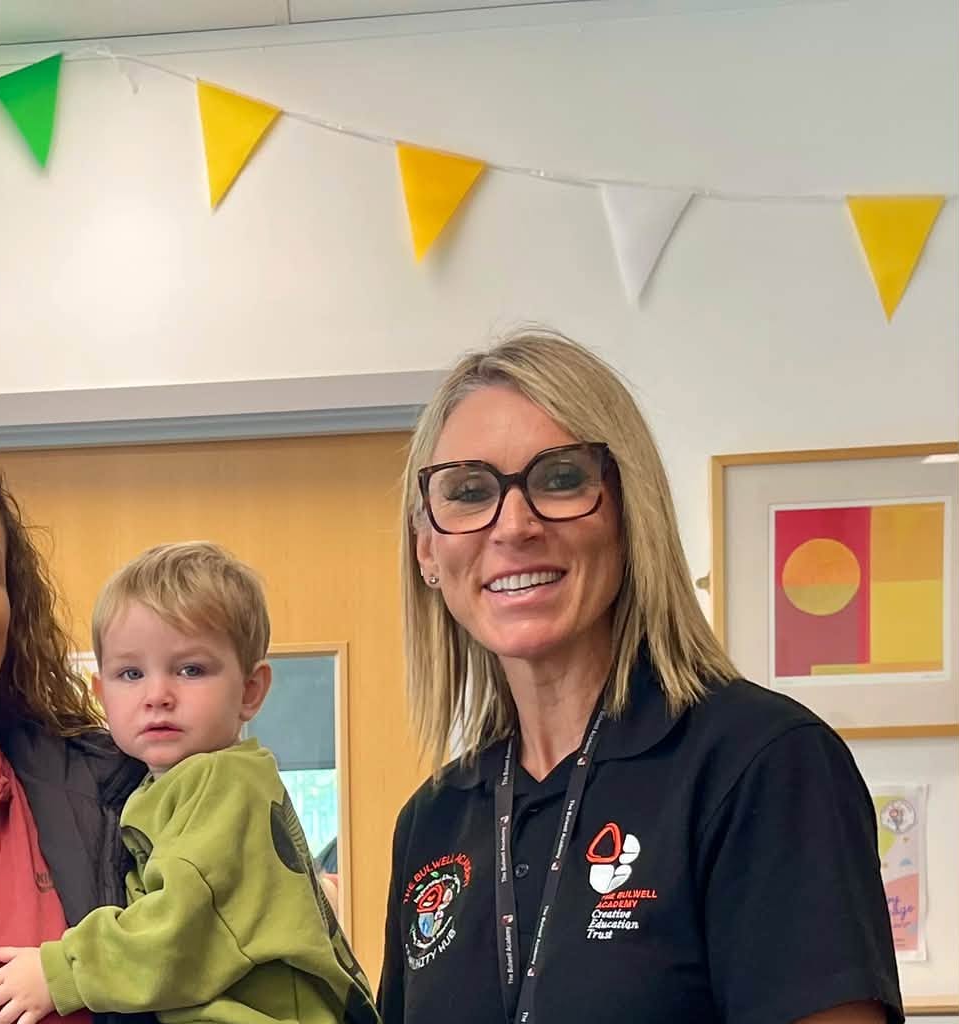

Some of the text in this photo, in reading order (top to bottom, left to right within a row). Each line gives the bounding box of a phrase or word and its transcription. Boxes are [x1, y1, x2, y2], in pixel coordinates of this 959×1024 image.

[413, 855, 453, 883] BULWELL
[616, 889, 658, 899] BULWELL
[594, 899, 639, 909] ACADEMY
[591, 909, 632, 919] Creative
[587, 919, 640, 930] Education
[504, 926, 513, 951] Academy
[586, 928, 614, 940] Trust
[505, 951, 514, 973] Bulwell
[521, 1011, 529, 1023] The
